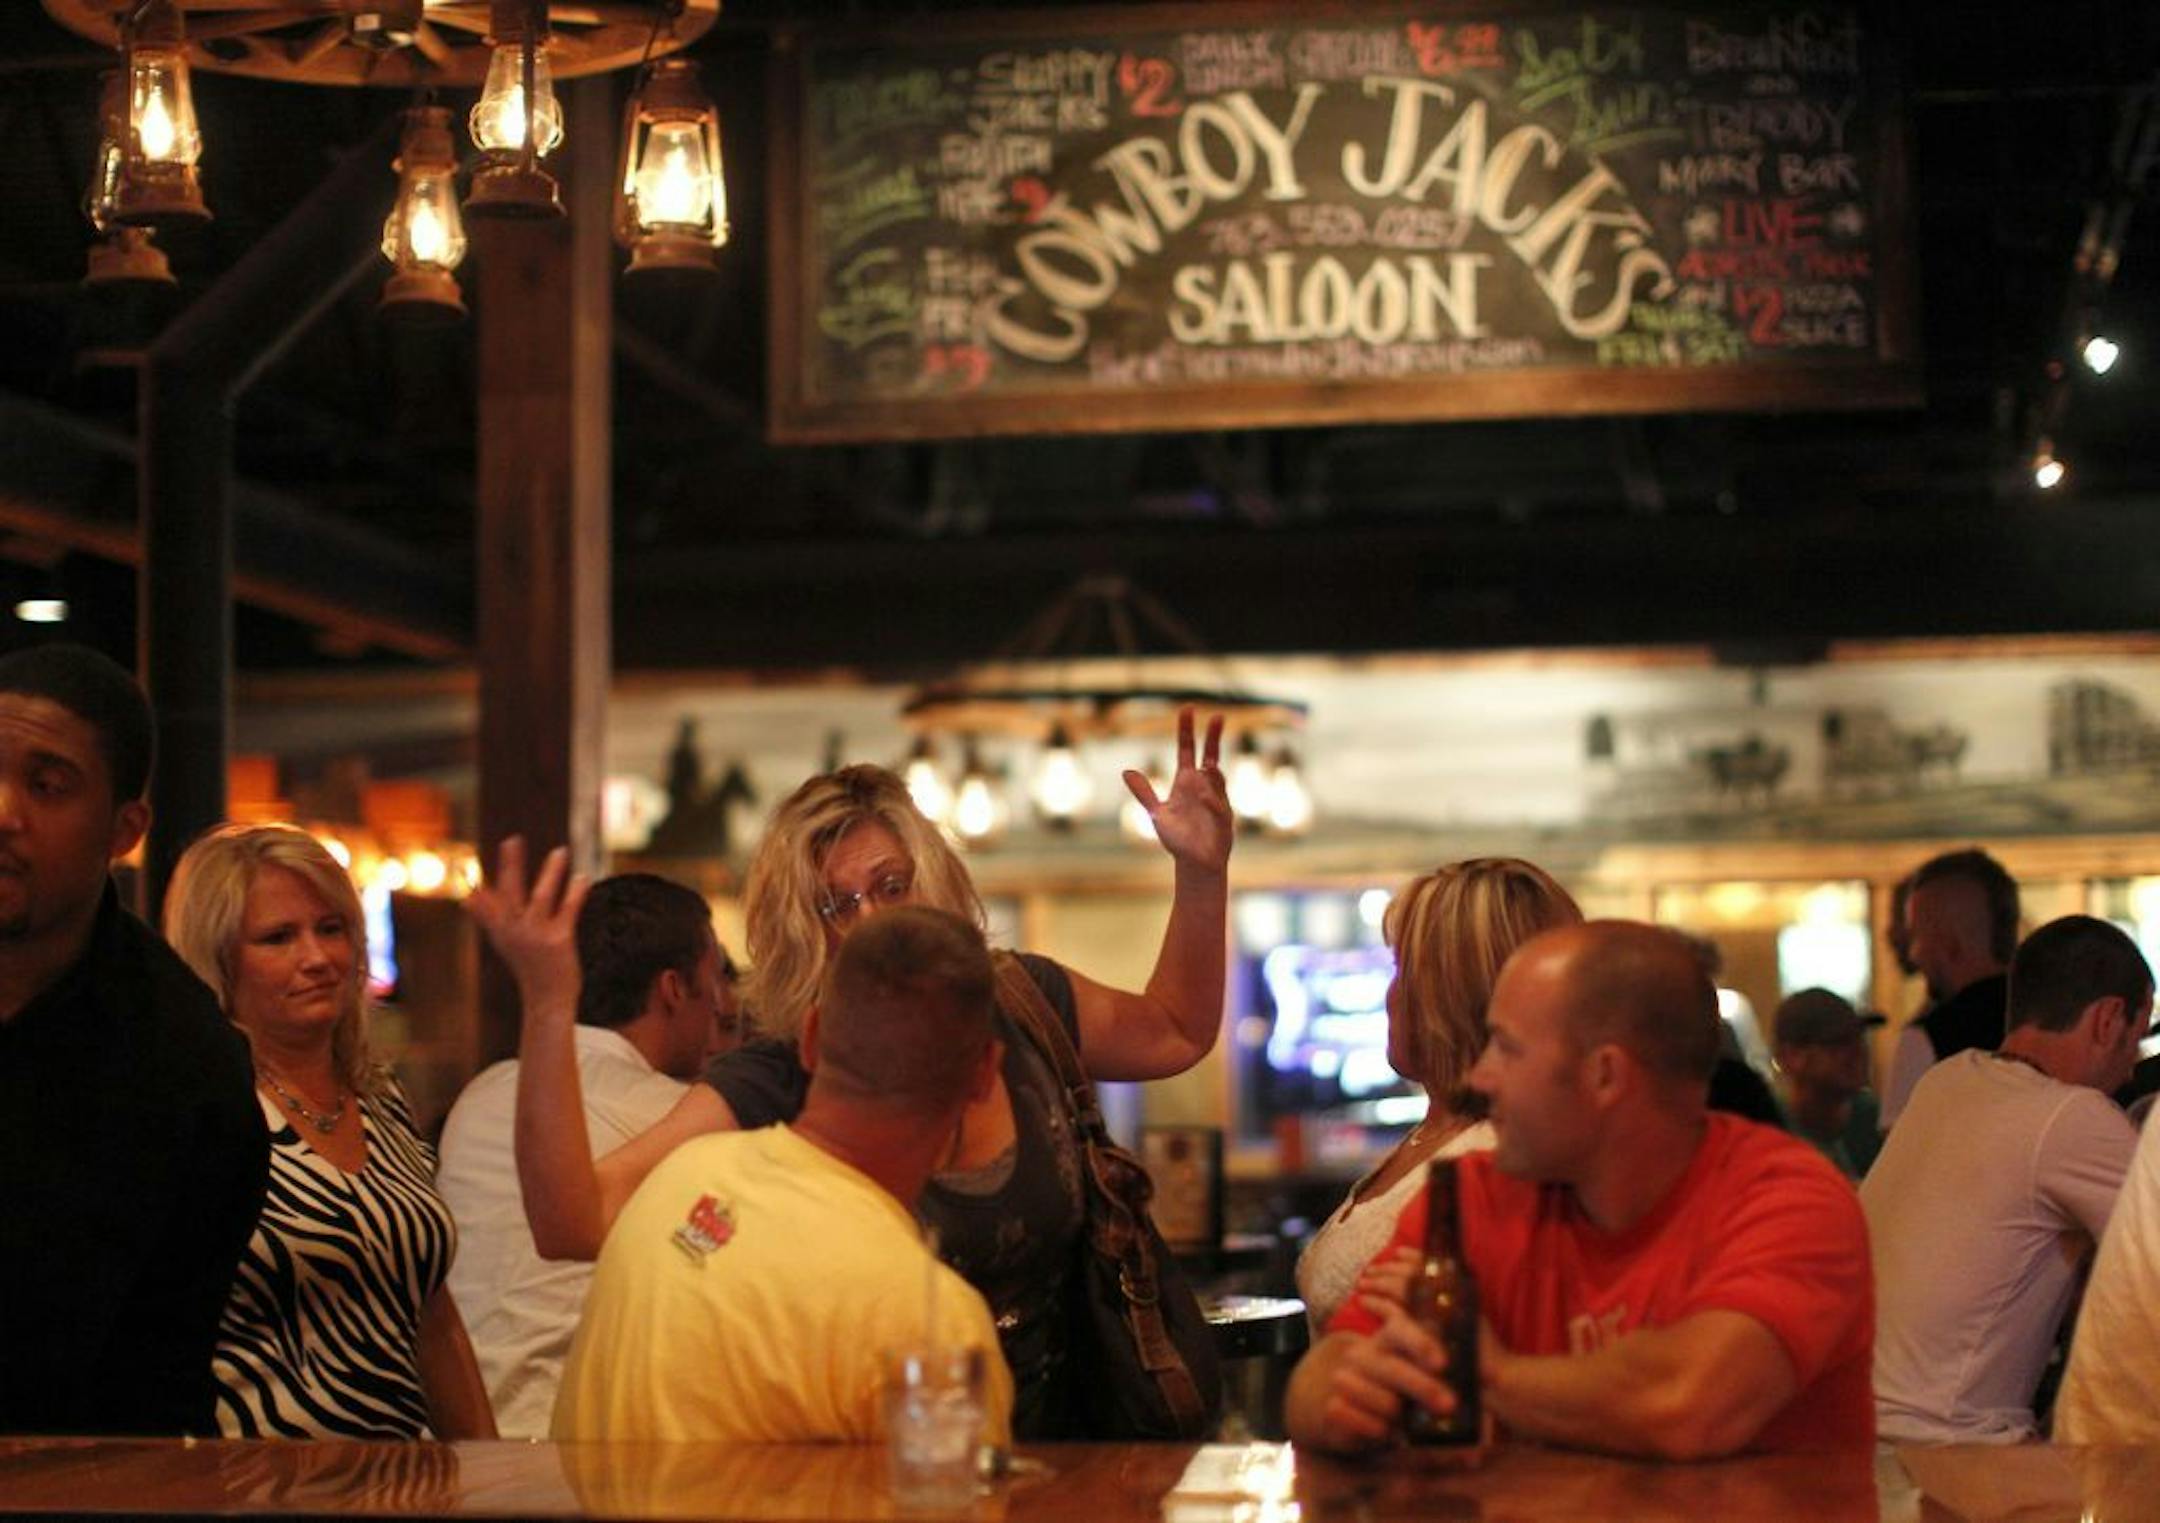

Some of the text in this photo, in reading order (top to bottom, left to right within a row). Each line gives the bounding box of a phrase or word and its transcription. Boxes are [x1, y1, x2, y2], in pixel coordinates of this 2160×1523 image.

[987, 74, 1677, 363] COWBOY JACK'S
[1722, 198, 1825, 252] LIVE
[1168, 251, 1494, 346] SALOON
